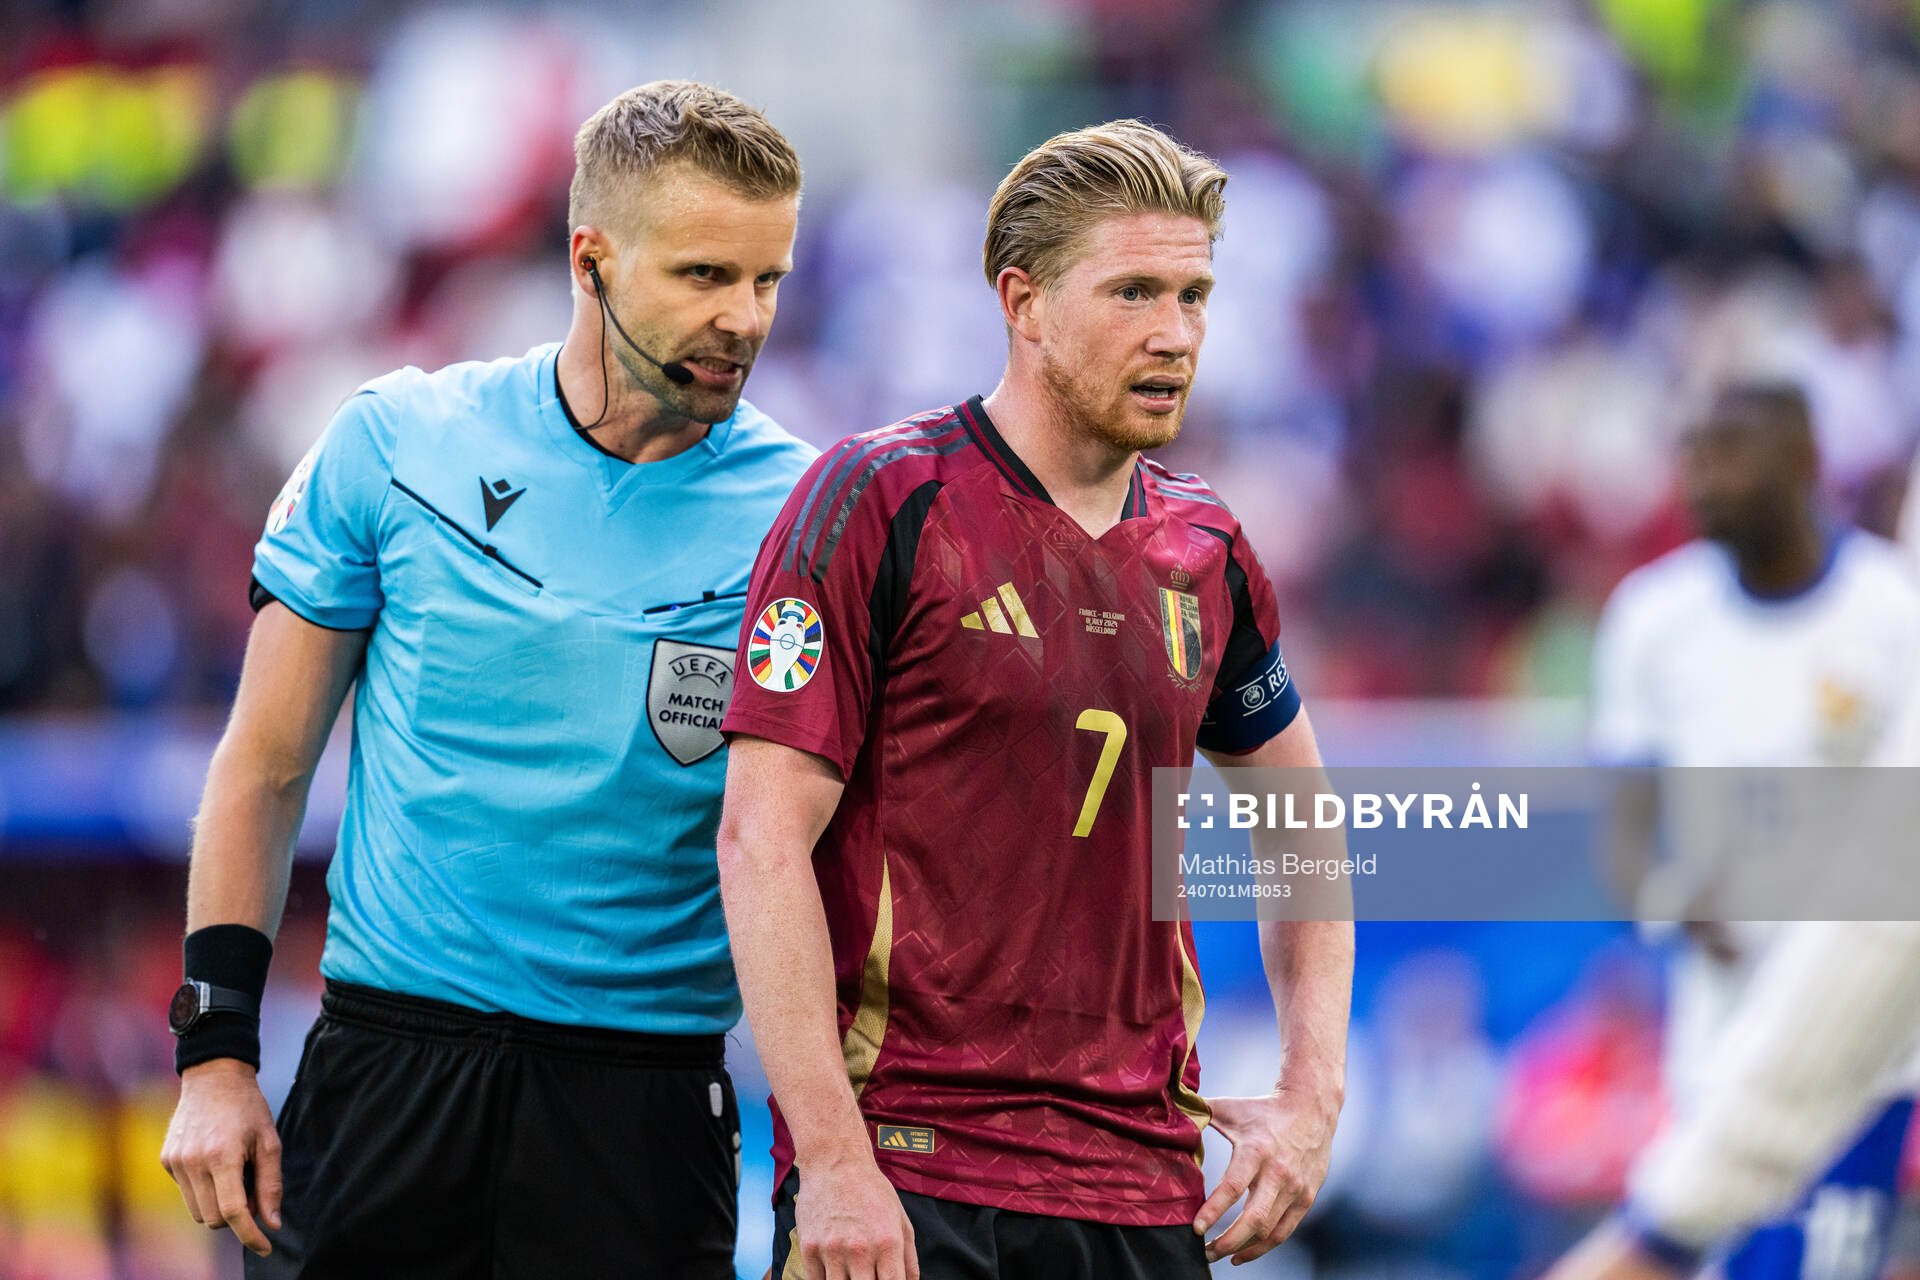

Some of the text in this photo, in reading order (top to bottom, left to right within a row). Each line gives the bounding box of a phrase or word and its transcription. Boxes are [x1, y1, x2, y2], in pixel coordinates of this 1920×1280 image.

[1079, 608, 1097, 617] FRANCE
[1104, 620, 1118, 628] 2024
[672, 658, 727, 683] UEFA
[668, 692, 724, 712] MATCH
[1072, 708, 1128, 838] 7
